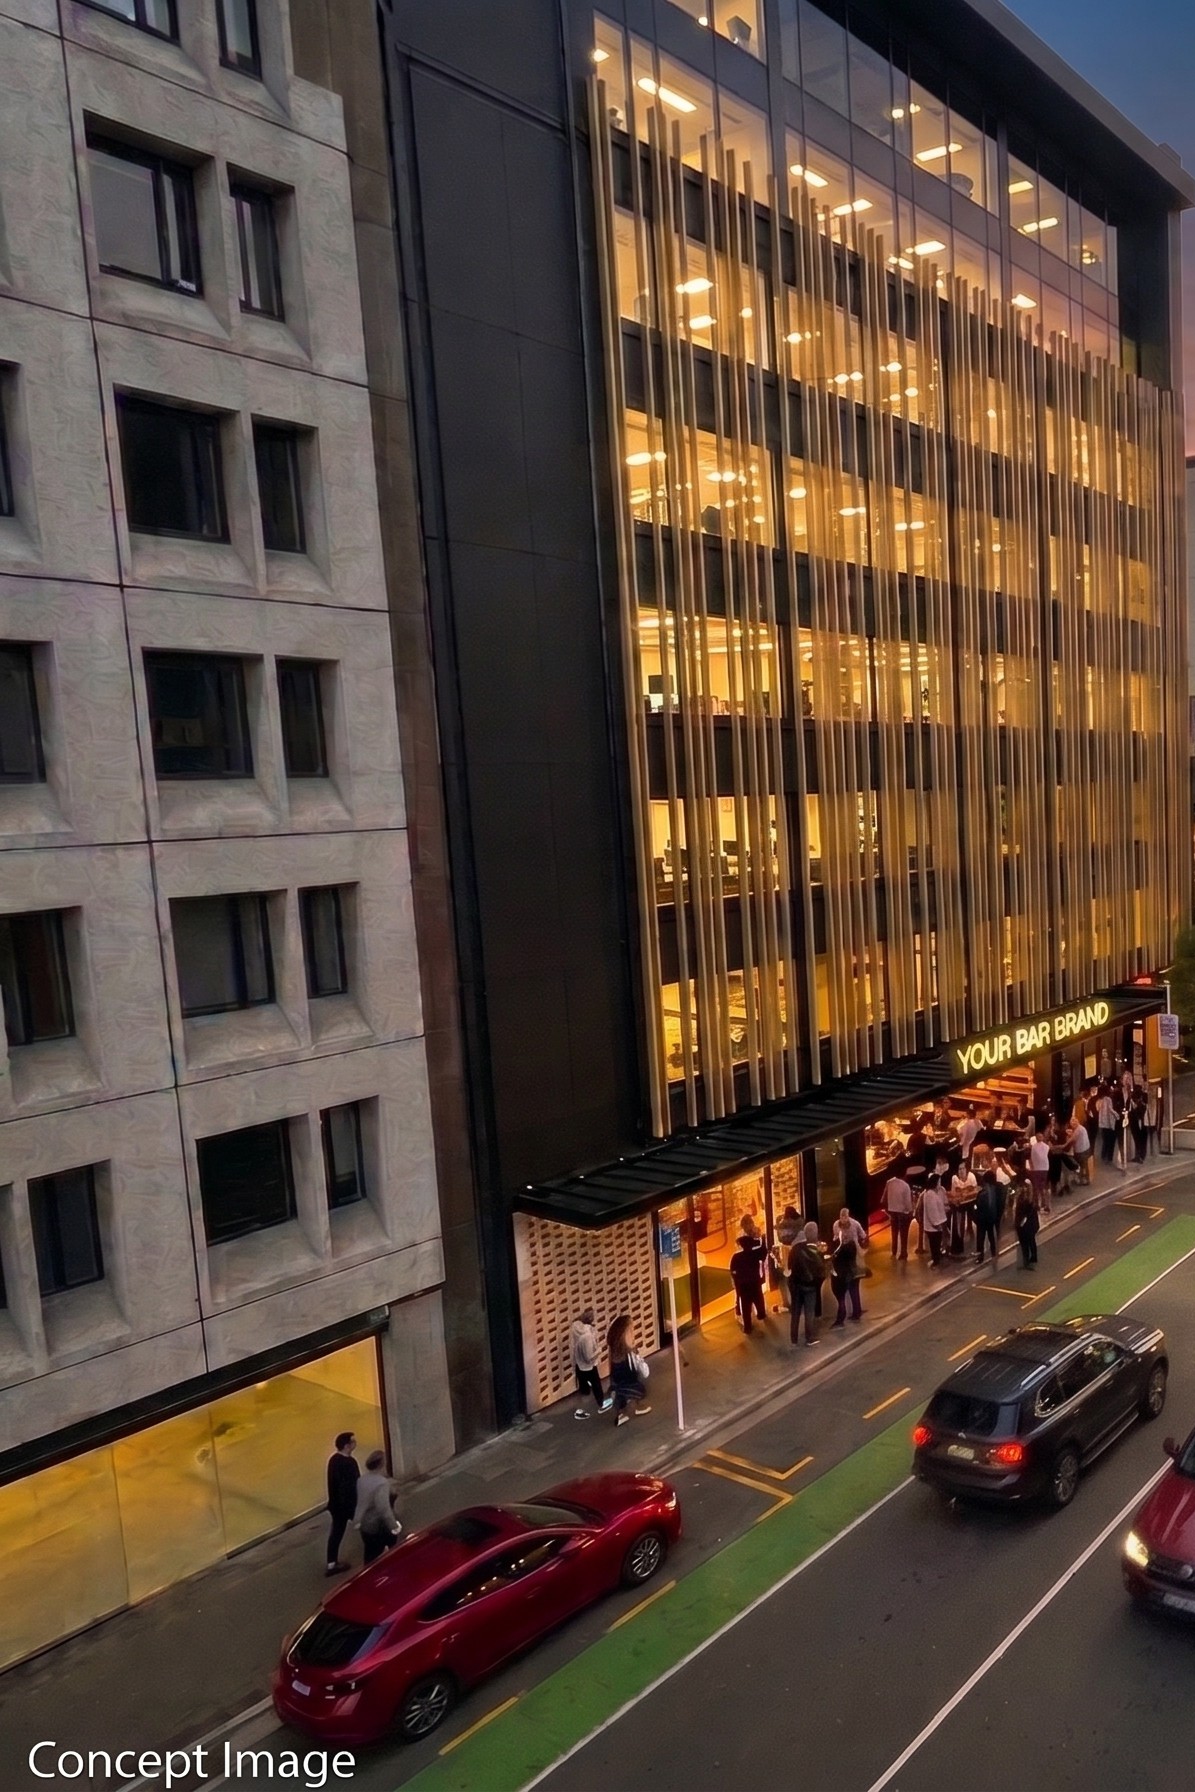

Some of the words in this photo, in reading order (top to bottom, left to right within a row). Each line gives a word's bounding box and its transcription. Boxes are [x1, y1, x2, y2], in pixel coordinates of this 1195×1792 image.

[956, 1034, 1012, 1075] YOUR
[1015, 1021, 1051, 1055] BAR
[1054, 1001, 1109, 1041] BRAND
